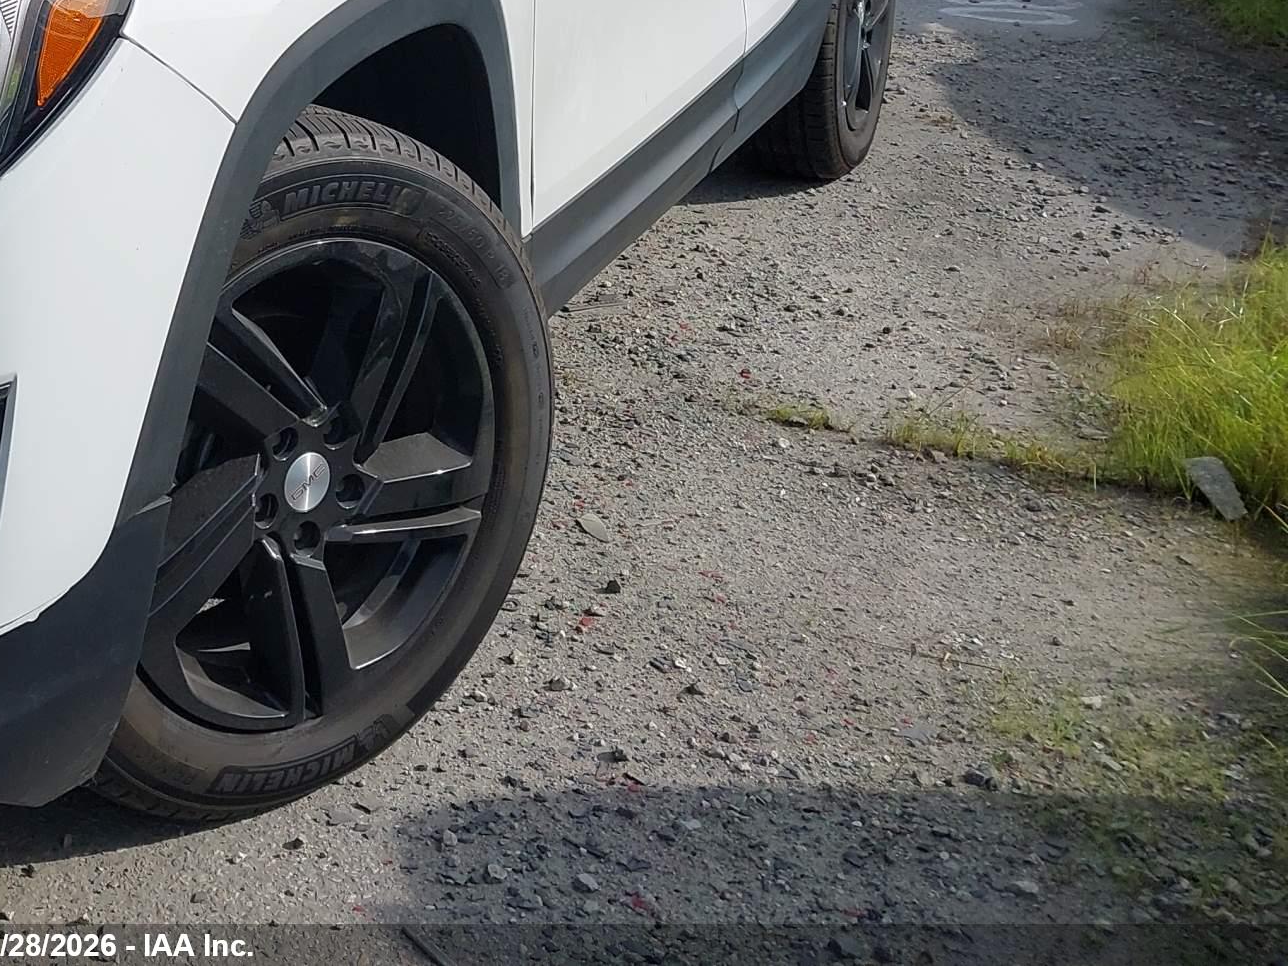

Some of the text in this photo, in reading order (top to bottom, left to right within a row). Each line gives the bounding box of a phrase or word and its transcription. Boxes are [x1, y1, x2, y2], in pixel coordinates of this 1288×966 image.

[283, 181, 422, 216] MICHELIN
[291, 461, 326, 501] GMC
[215, 740, 355, 793] MICHELIN
